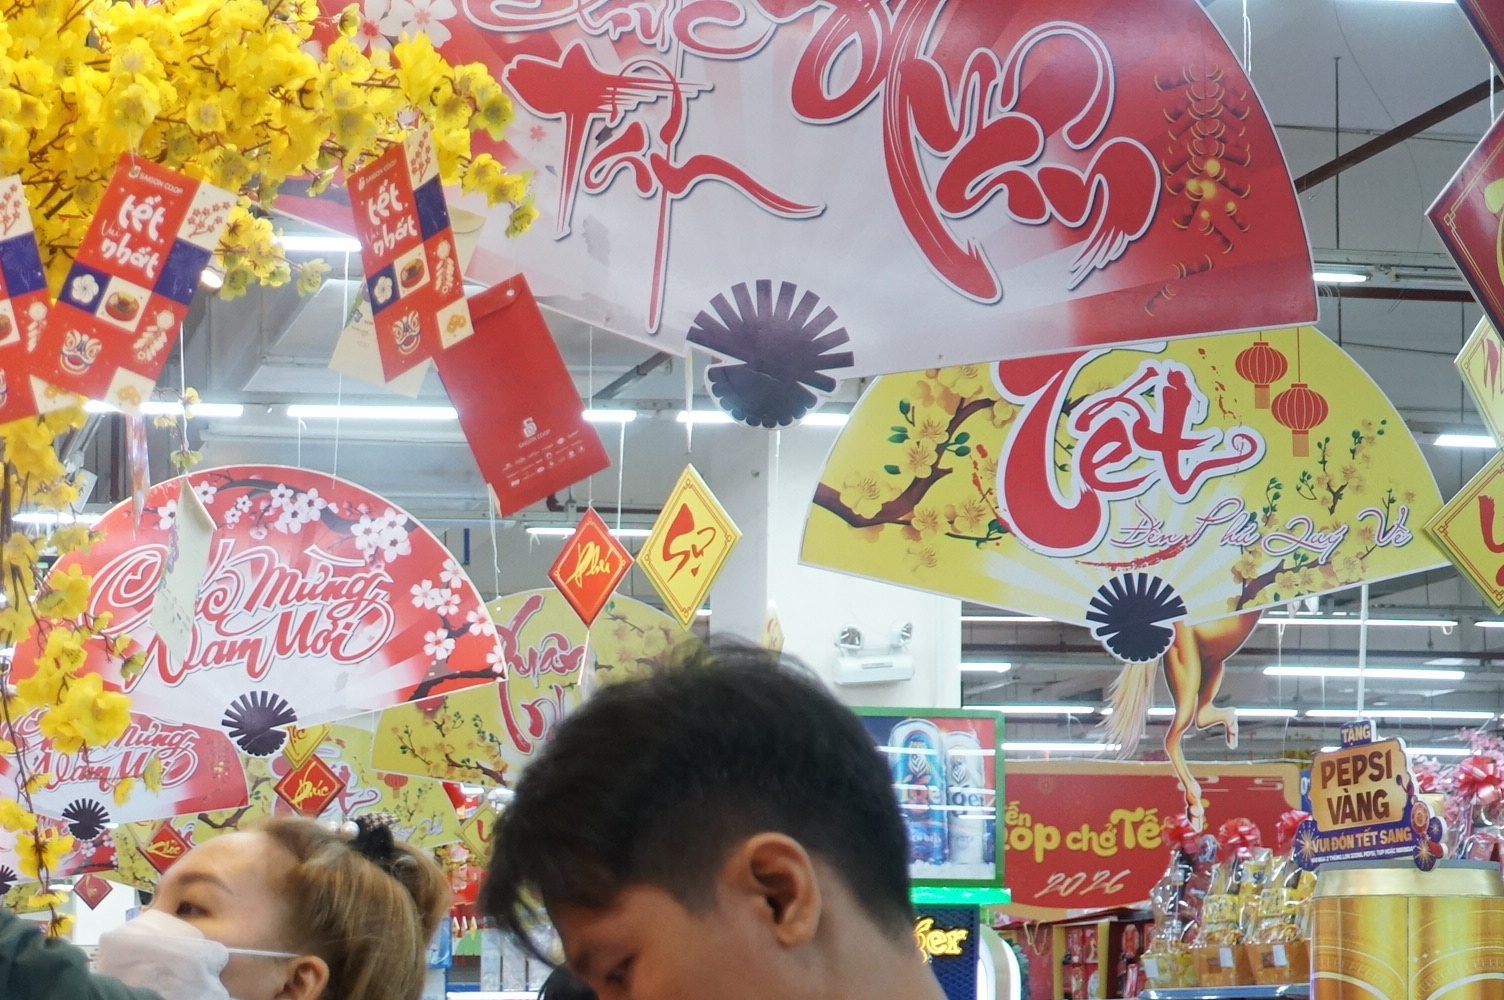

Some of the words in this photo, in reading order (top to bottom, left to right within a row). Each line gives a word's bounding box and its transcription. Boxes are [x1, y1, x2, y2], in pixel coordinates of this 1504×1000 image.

[139, 170, 164, 189] SAIGON
[116, 193, 166, 243] tết
[367, 179, 405, 227] tết
[100, 234, 160, 280] nhất
[373, 216, 418, 257] nhất
[1186, 496, 1262, 548] Phú
[1263, 515, 1349, 565] Quý
[1340, 724, 1372, 747] TẶNG
[1320, 748, 1394, 790] PEPSI
[1004, 800, 1032, 827] ến
[1326, 788, 1391, 826] VÀNG
[1004, 822, 1061, 864] op
[1110, 806, 1164, 851] Tế
[1312, 838, 1331, 854] VUI
[1332, 832, 1355, 850] ĐÓN
[1356, 827, 1380, 847] TẾT
[1380, 825, 1414, 846] SANG
[1033, 868, 1133, 899] 2026
